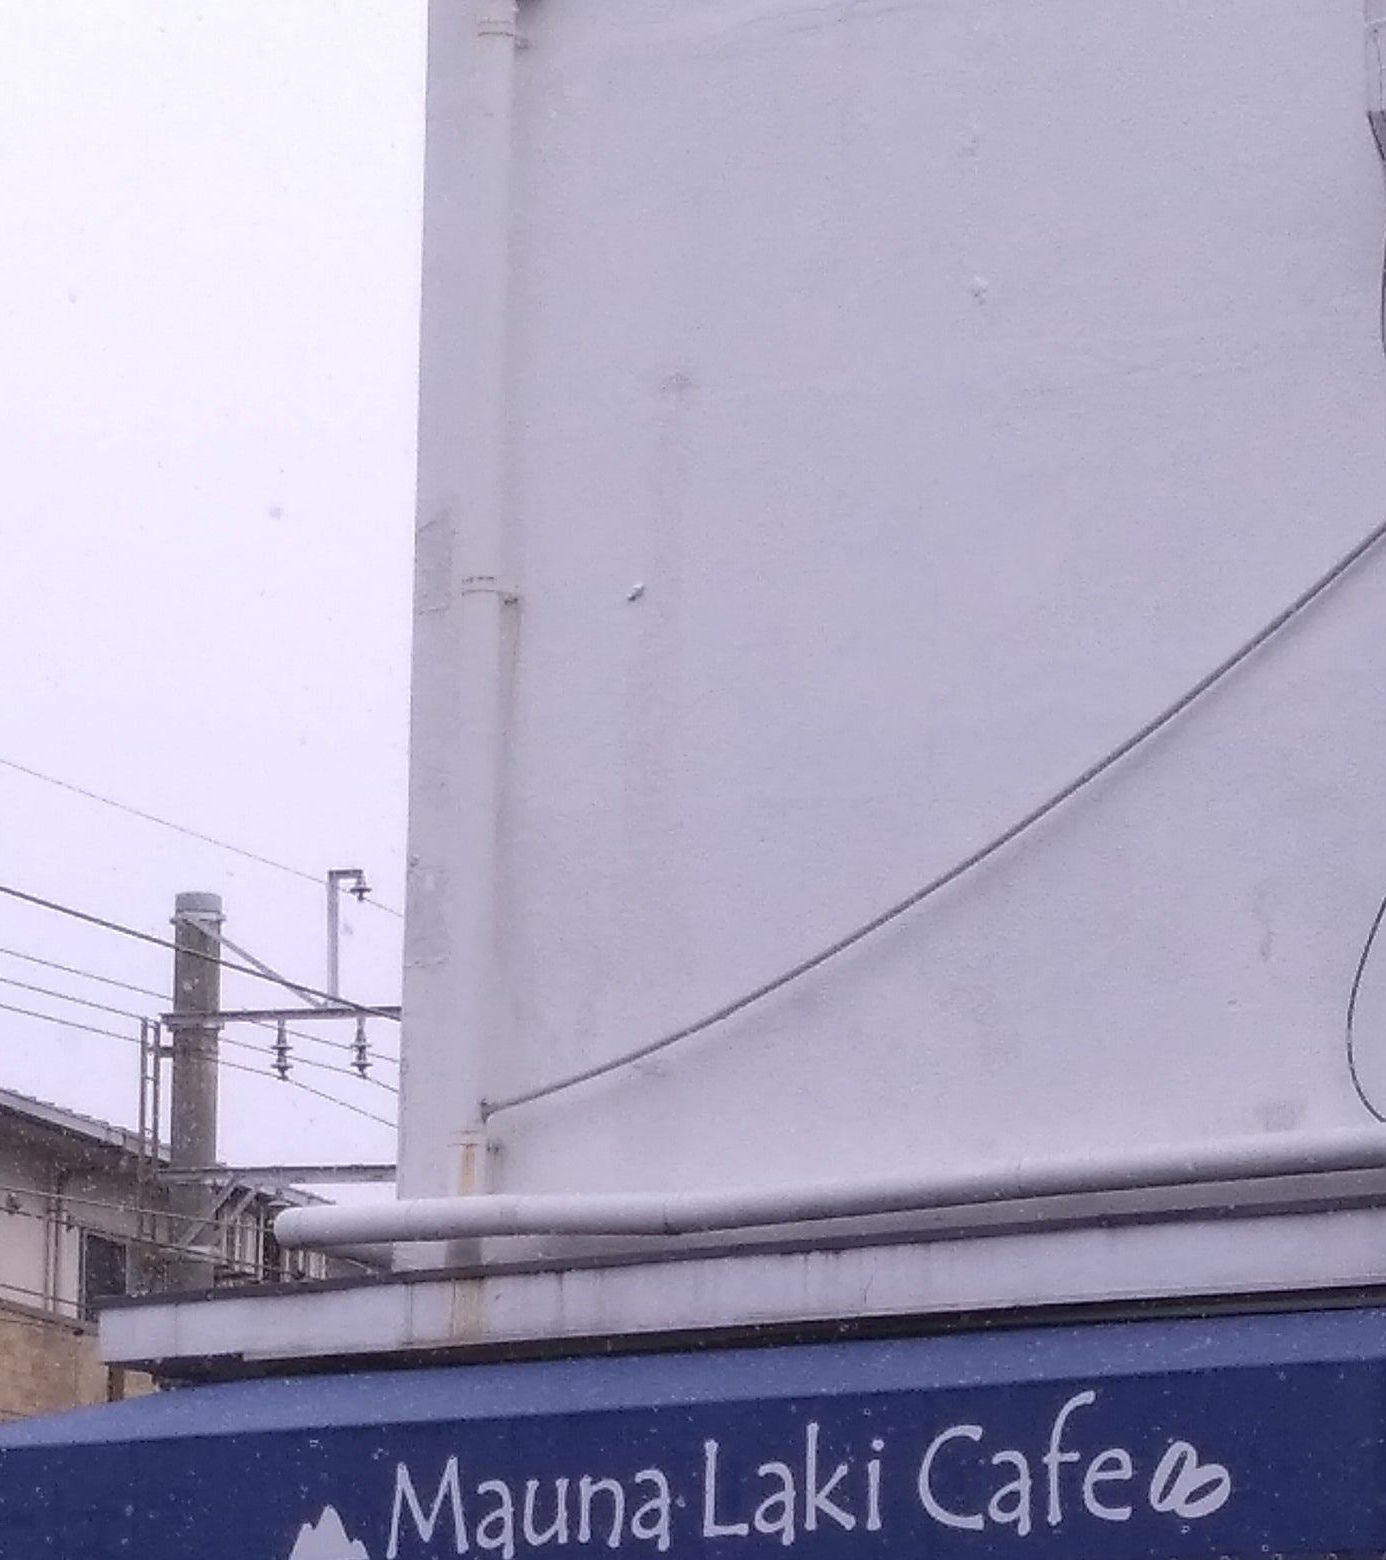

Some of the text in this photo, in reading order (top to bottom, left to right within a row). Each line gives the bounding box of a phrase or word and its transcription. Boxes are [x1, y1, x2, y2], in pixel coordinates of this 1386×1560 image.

[386, 1390, 1133, 1560] Mauna Laki Cafe
